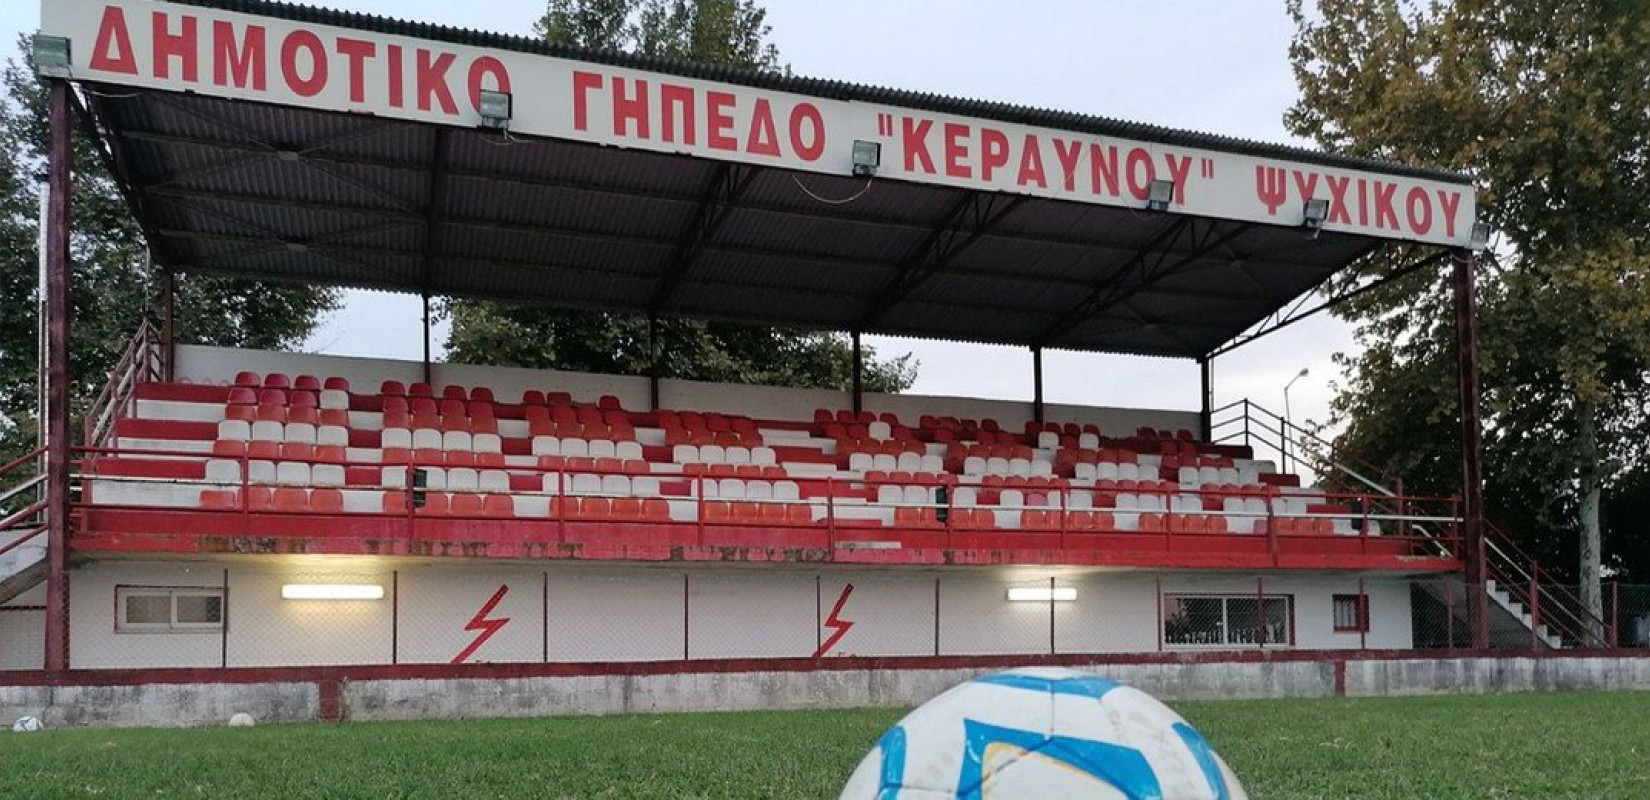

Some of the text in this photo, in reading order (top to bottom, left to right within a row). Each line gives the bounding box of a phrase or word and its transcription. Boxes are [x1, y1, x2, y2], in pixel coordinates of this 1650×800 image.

[90, 6, 1461, 238] ΔΗΜΟΤΙΚΟ ΓΗΠΕΔΟ "ΚΕΡΑΥΝΟΥ" ΨΥΧΙΚΟΥ
